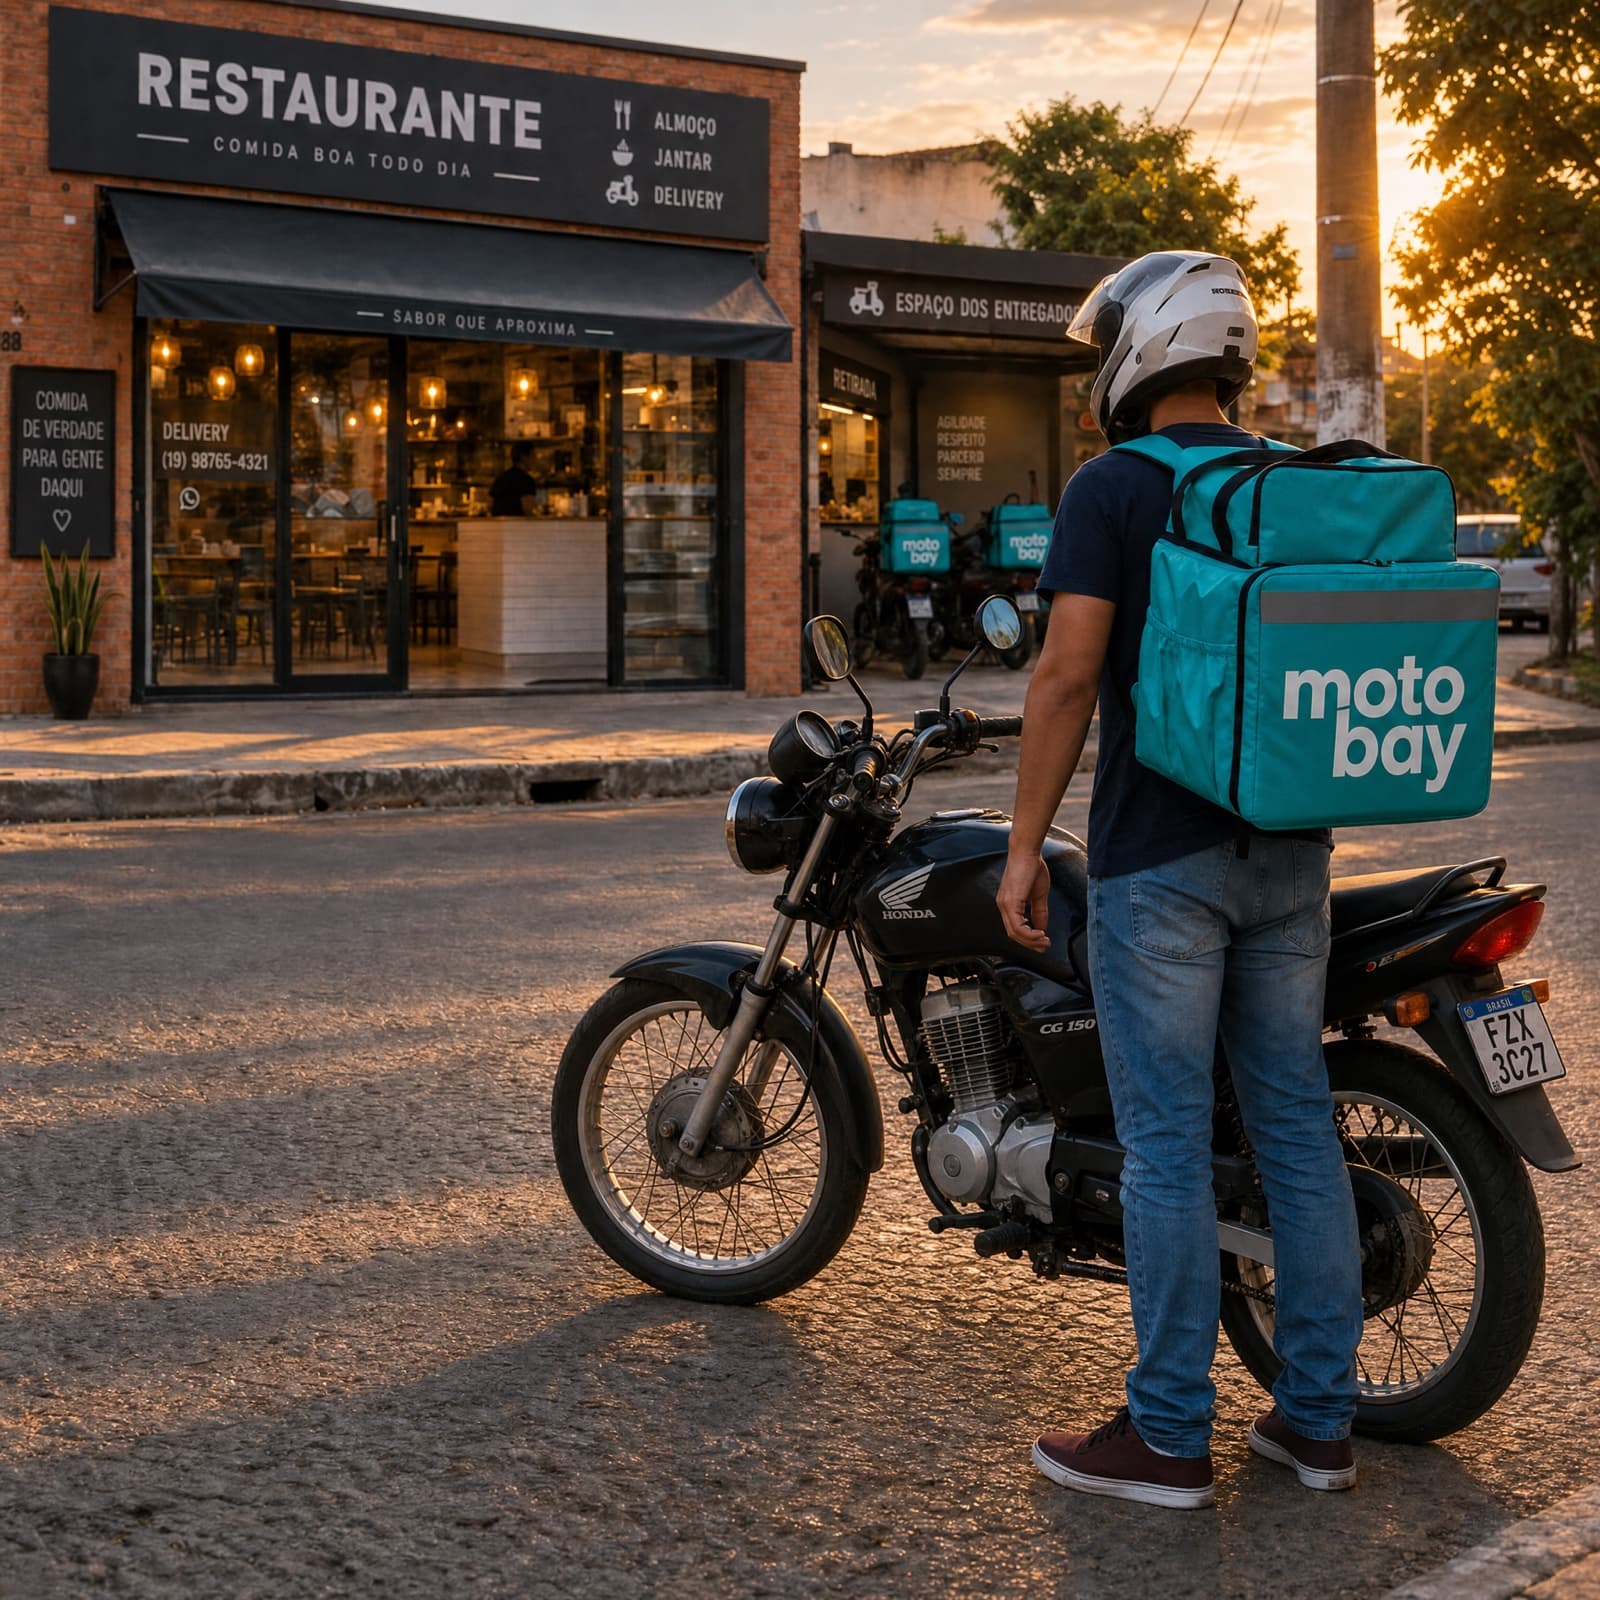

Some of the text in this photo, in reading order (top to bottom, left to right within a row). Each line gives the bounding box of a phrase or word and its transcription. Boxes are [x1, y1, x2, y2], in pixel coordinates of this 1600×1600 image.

[137, 52, 542, 151] RESTAURANTE
[654, 111, 717, 140] ALMOÇO
[213, 136, 471, 178] COMIDA BOA TODO DIA
[654, 148, 712, 171] JANTAR
[654, 185, 724, 211] DELIVERY
[895, 292, 954, 319] ESPAÇO
[960, 297, 989, 319] DOS
[393, 309, 577, 337] SABOR QUE APROXIMA
[36, 390, 88, 412] COMIDA
[23, 419, 104, 440] DE VERDADE
[163, 421, 230, 442] DELIVERY
[937, 433, 986, 448] RESPEITO
[22, 448, 104, 469] PARA GENTE
[162, 451, 269, 471] (19) 98765-4321
[937, 467, 983, 482] SEMPRE
[41, 477, 83, 498] DAQUI
[902, 537, 941, 552] moto
[1009, 533, 1048, 549] moto
[910, 549, 939, 567] bay
[1017, 546, 1046, 564] bay
[1282, 655, 1466, 720] moto
[1331, 707, 1468, 793] bay
[882, 909, 937, 920] HONDA
[1486, 997, 1514, 1014] BRASIL
[1039, 1018, 1096, 1035] CG 150
[1482, 1008, 1535, 1049] FZX
[1491, 1042, 1549, 1085] 3C27
